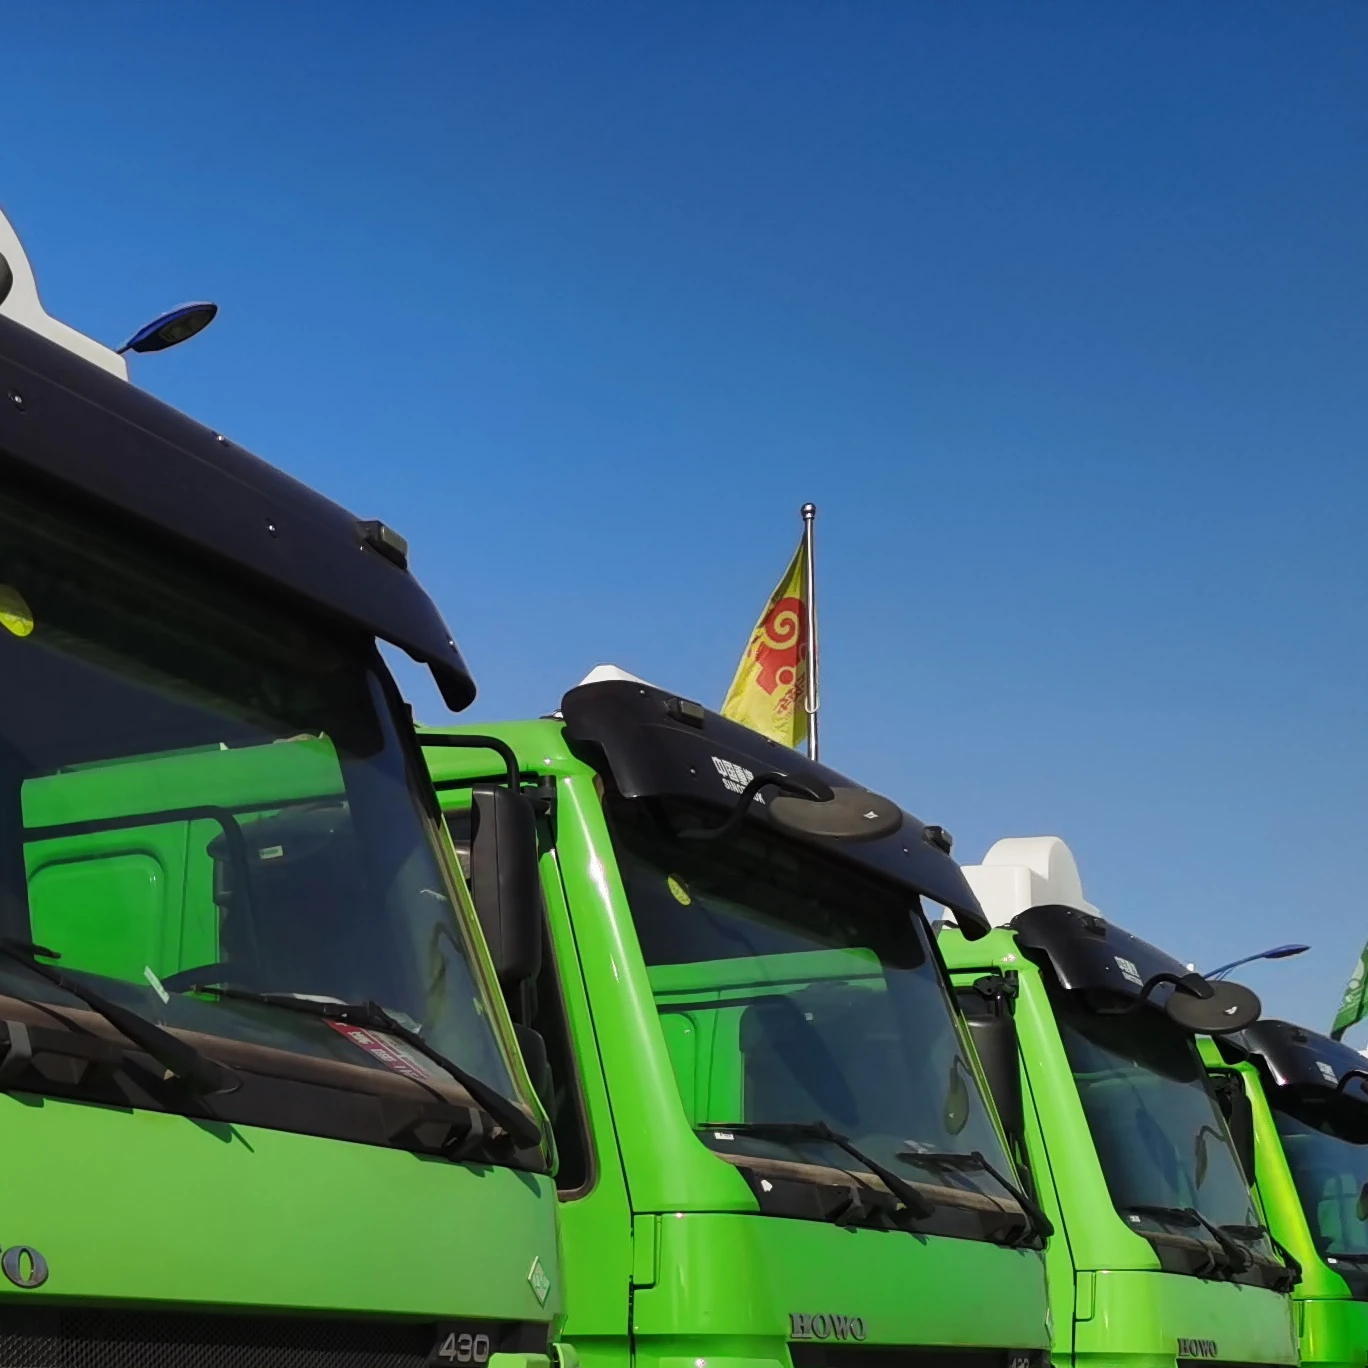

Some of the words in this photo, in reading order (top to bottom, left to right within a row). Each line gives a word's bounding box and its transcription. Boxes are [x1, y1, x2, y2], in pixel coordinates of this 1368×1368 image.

[789, 1313, 867, 1341] HOWO
[438, 1332, 490, 1363] 430
[1177, 1338, 1218, 1358] HOWO
